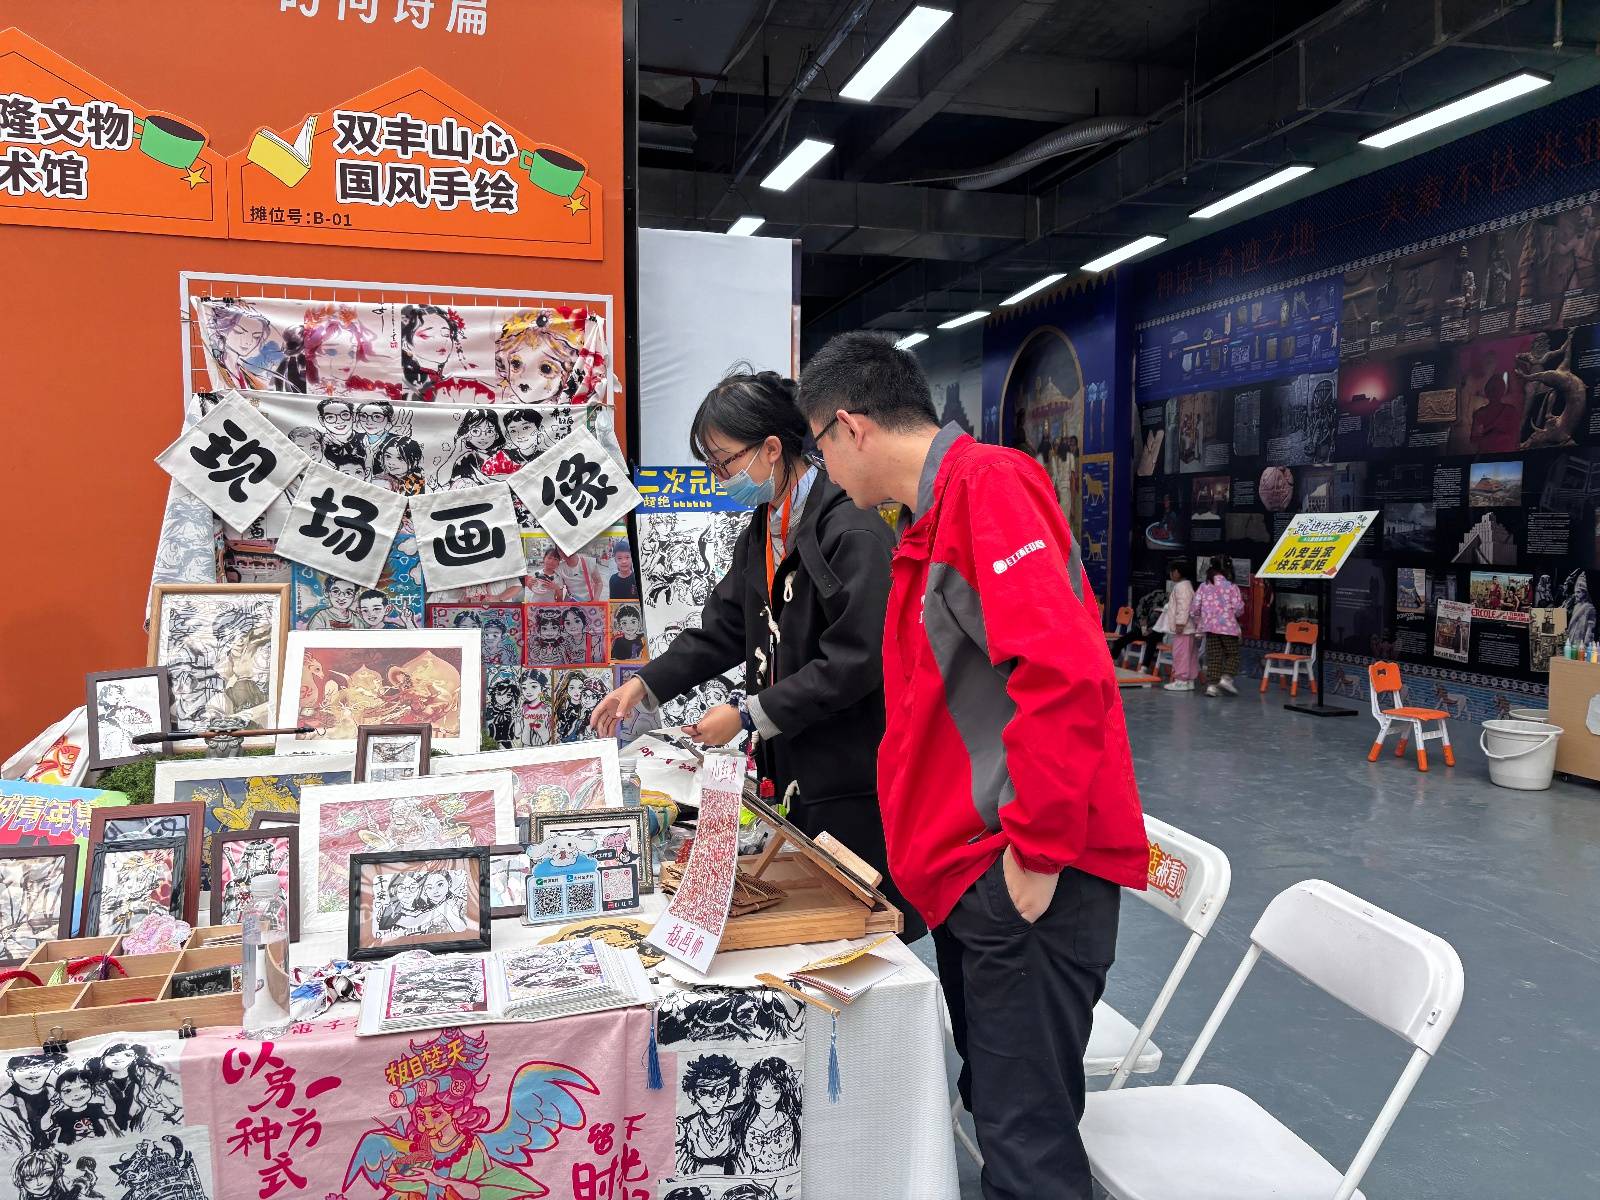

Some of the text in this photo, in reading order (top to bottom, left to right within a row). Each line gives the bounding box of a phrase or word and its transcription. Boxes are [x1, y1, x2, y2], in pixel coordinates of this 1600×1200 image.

[334, 111, 516, 164] 双丰山心
[336, 162, 518, 213] 国风手绘
[1275, 559, 1329, 572] 快乐掌柜
[1283, 546, 1336, 559] 小鬼当家
